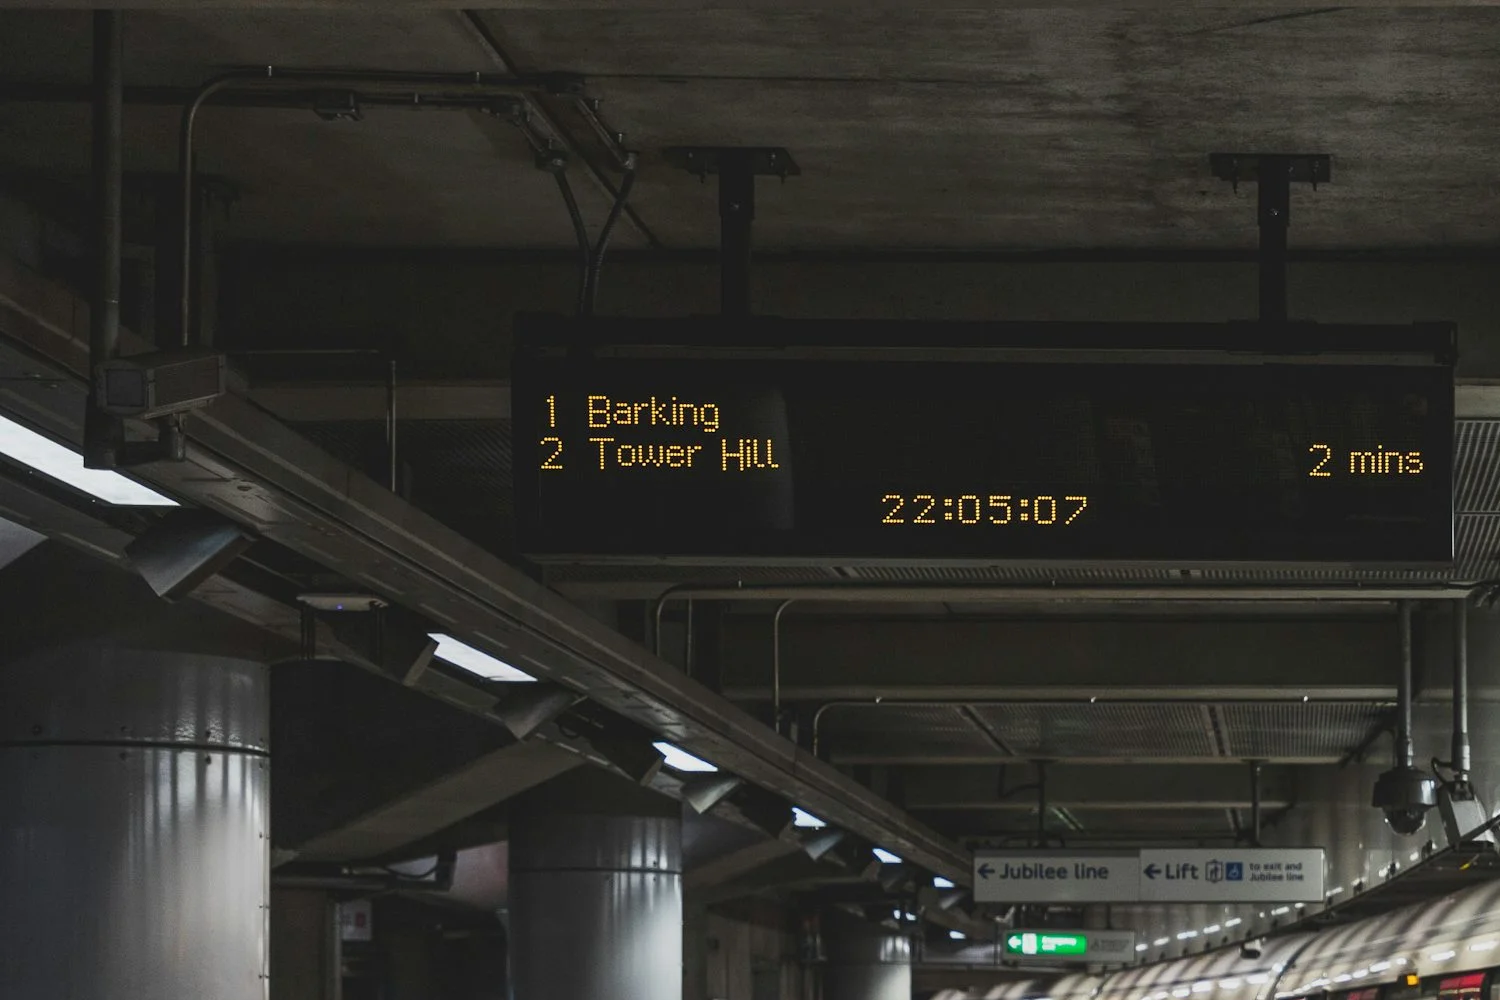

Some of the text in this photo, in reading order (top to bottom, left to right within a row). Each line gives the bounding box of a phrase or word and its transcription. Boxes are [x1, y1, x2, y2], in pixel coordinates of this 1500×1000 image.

[545, 394, 721, 434] 1 Barking
[539, 436, 781, 473] 2 Tower Hill
[1308, 443, 1425, 478] 2 mins
[880, 493, 1089, 526] 22:05:07
[999, 863, 1109, 880] Jubilee line
[1165, 863, 1198, 880] Lift
[1249, 862, 1302, 871] to exit and
[1249, 873, 1303, 882] Jubilee line
